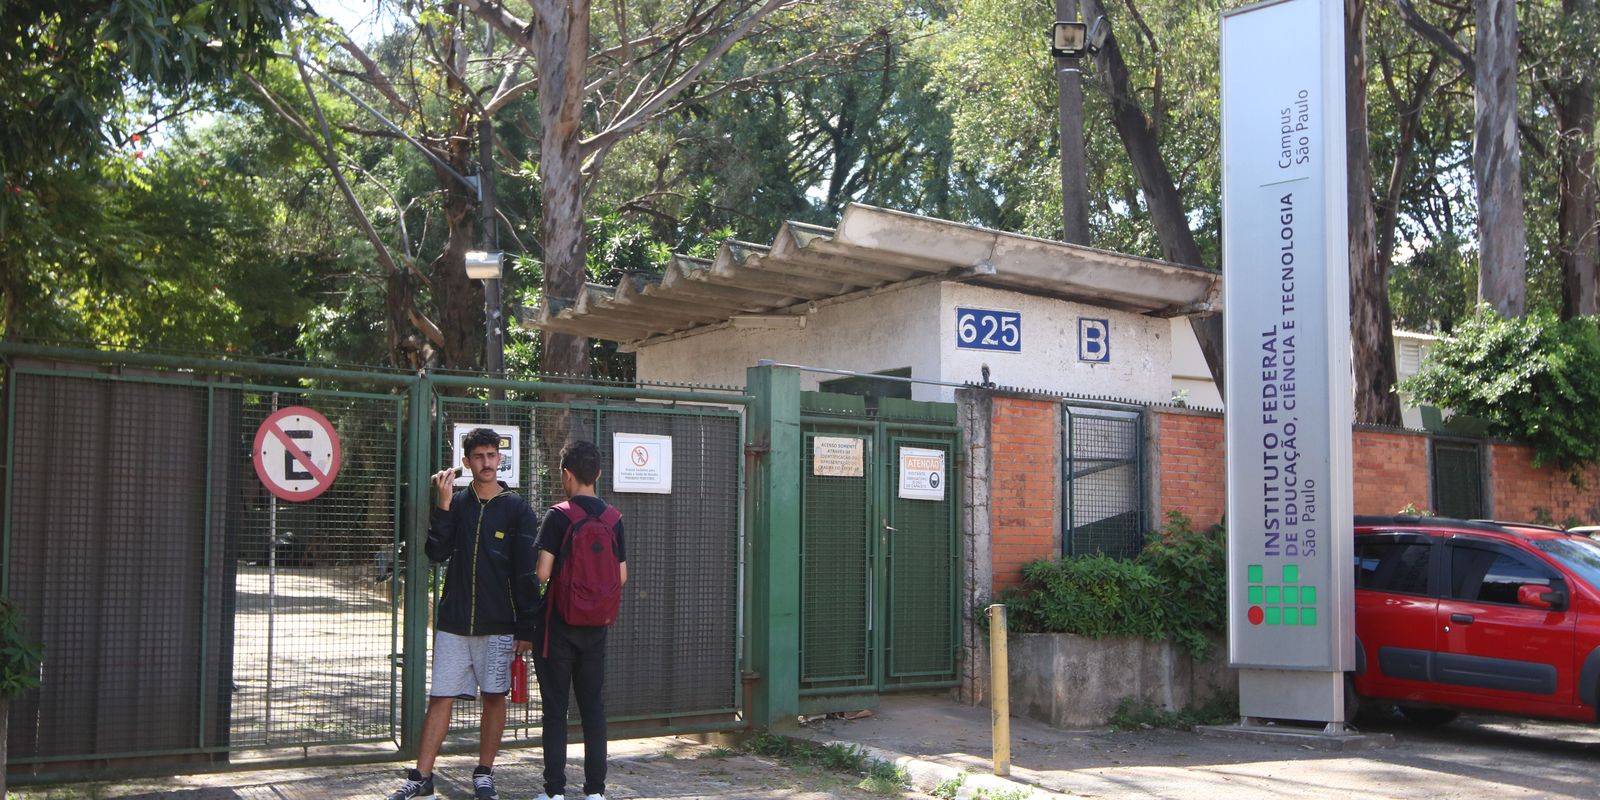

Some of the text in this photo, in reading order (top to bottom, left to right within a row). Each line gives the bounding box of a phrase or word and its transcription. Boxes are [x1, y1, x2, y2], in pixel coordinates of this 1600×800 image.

[1278, 107, 1295, 169] Campus
[1294, 89, 1310, 165] São Paulo
[959, 313, 1019, 347] 625
[1081, 319, 1106, 361] B
[1279, 193, 1301, 557] DE EDUCAÇÃO, CIÊNCIA E TECNOLOGIA
[284, 430, 313, 480] E
[907, 458, 939, 470] ATENÇÃO
[1262, 324, 1280, 557] INSTITUTO FEDERAL
[1300, 479, 1316, 557] São Paulo
[496, 660, 507, 688] JOHN
